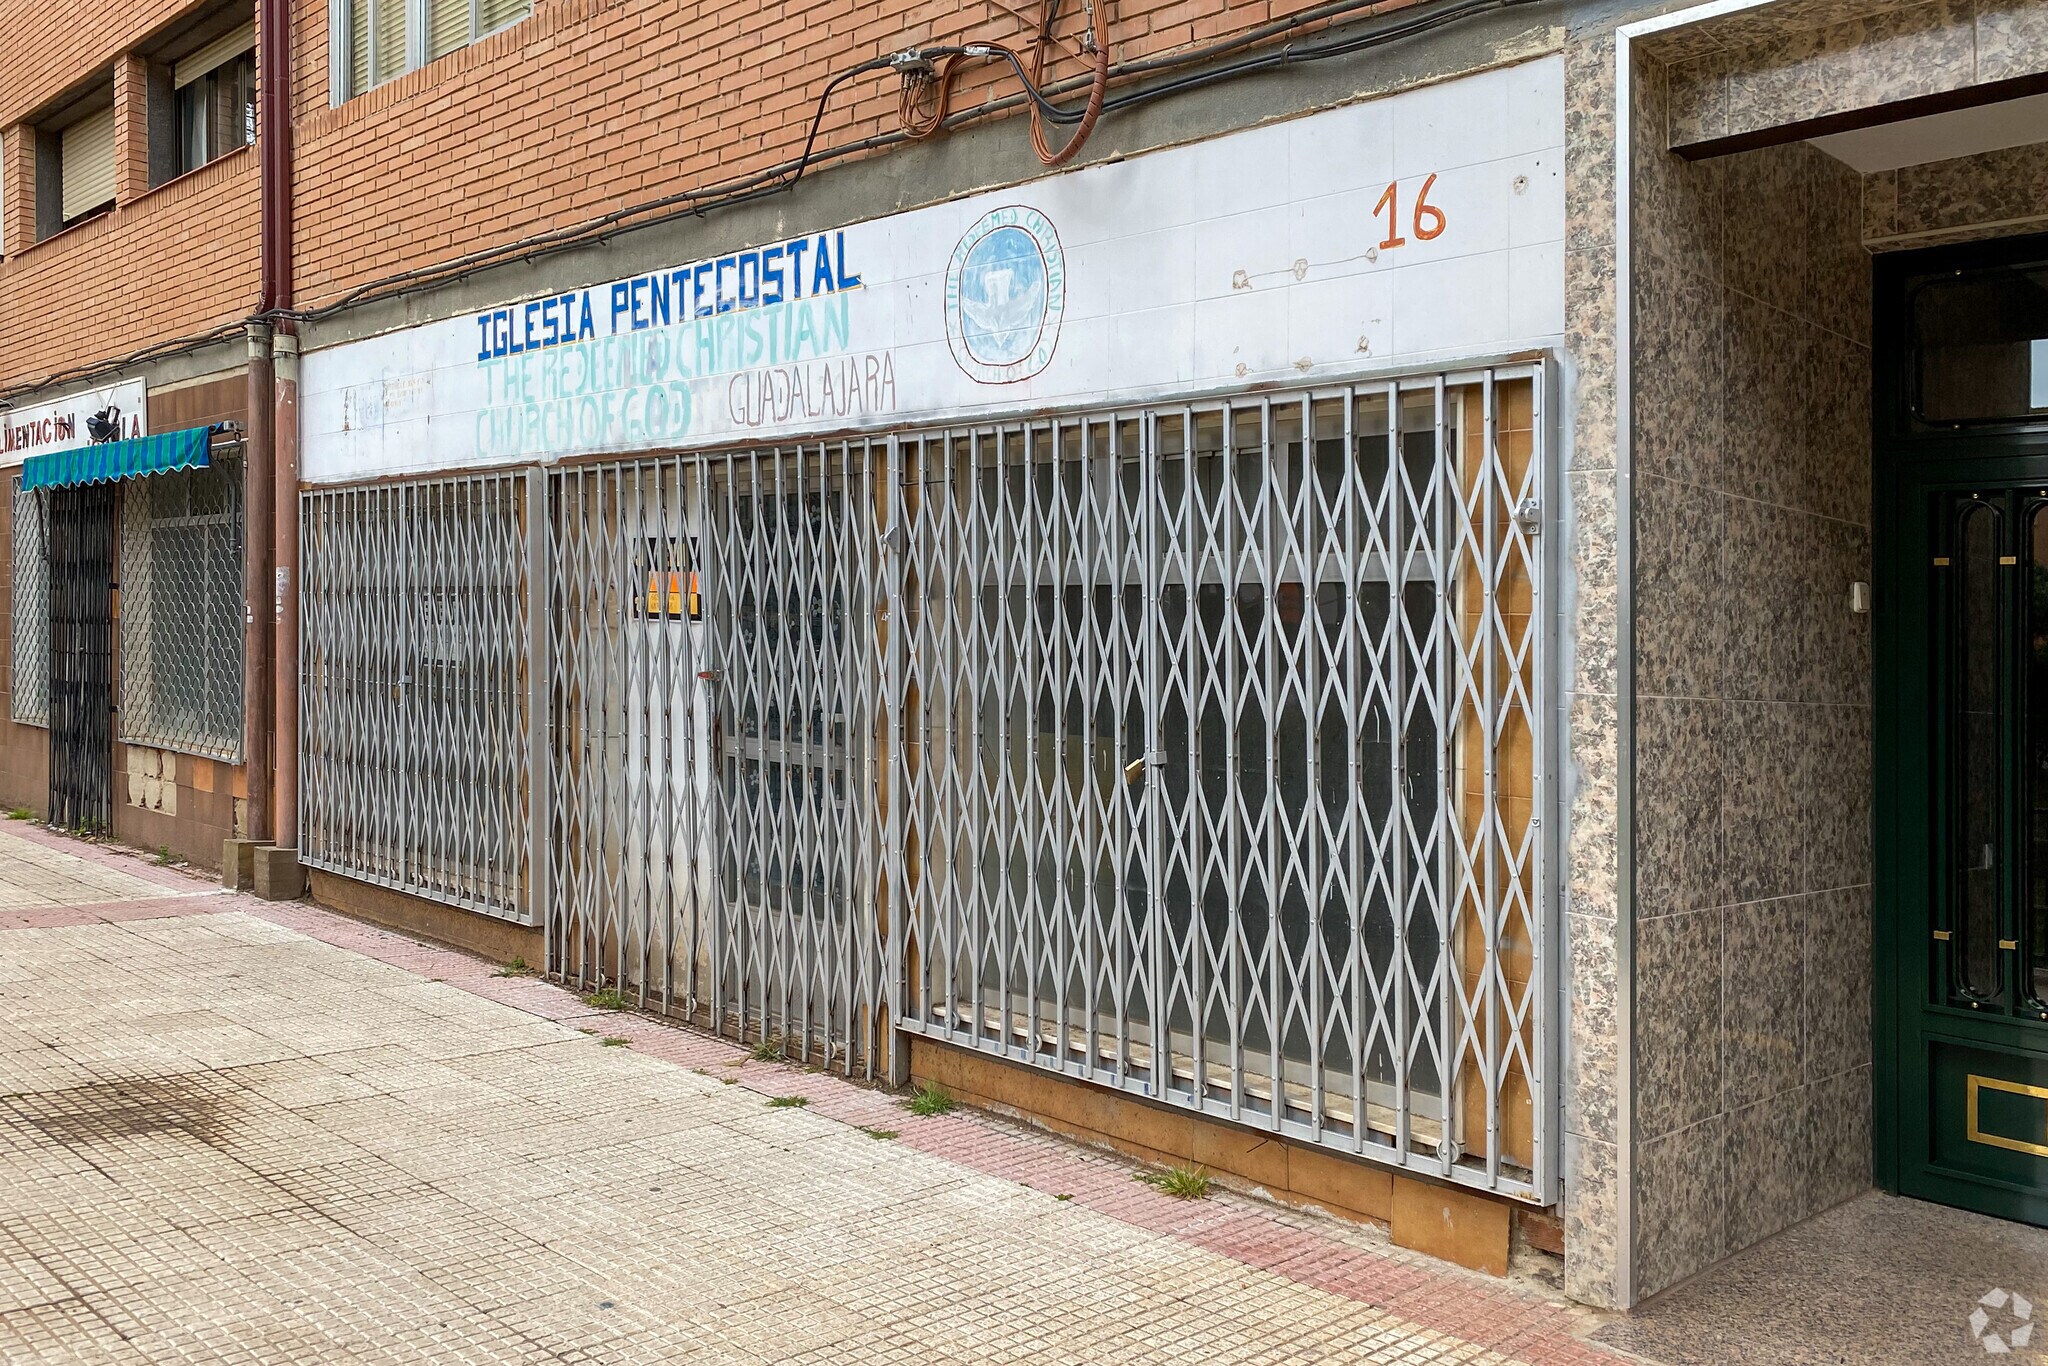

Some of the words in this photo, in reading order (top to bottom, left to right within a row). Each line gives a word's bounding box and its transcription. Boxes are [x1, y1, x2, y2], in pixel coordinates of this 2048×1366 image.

[1373, 172, 1446, 250] 16
[477, 290, 596, 362] IGLESIA
[611, 231, 861, 334] PENTECOSTAL
[477, 351, 536, 404] THE
[580, 394, 616, 446] OF
[621, 380, 693, 443] GOD
[728, 350, 897, 427] GUADALAJARA
